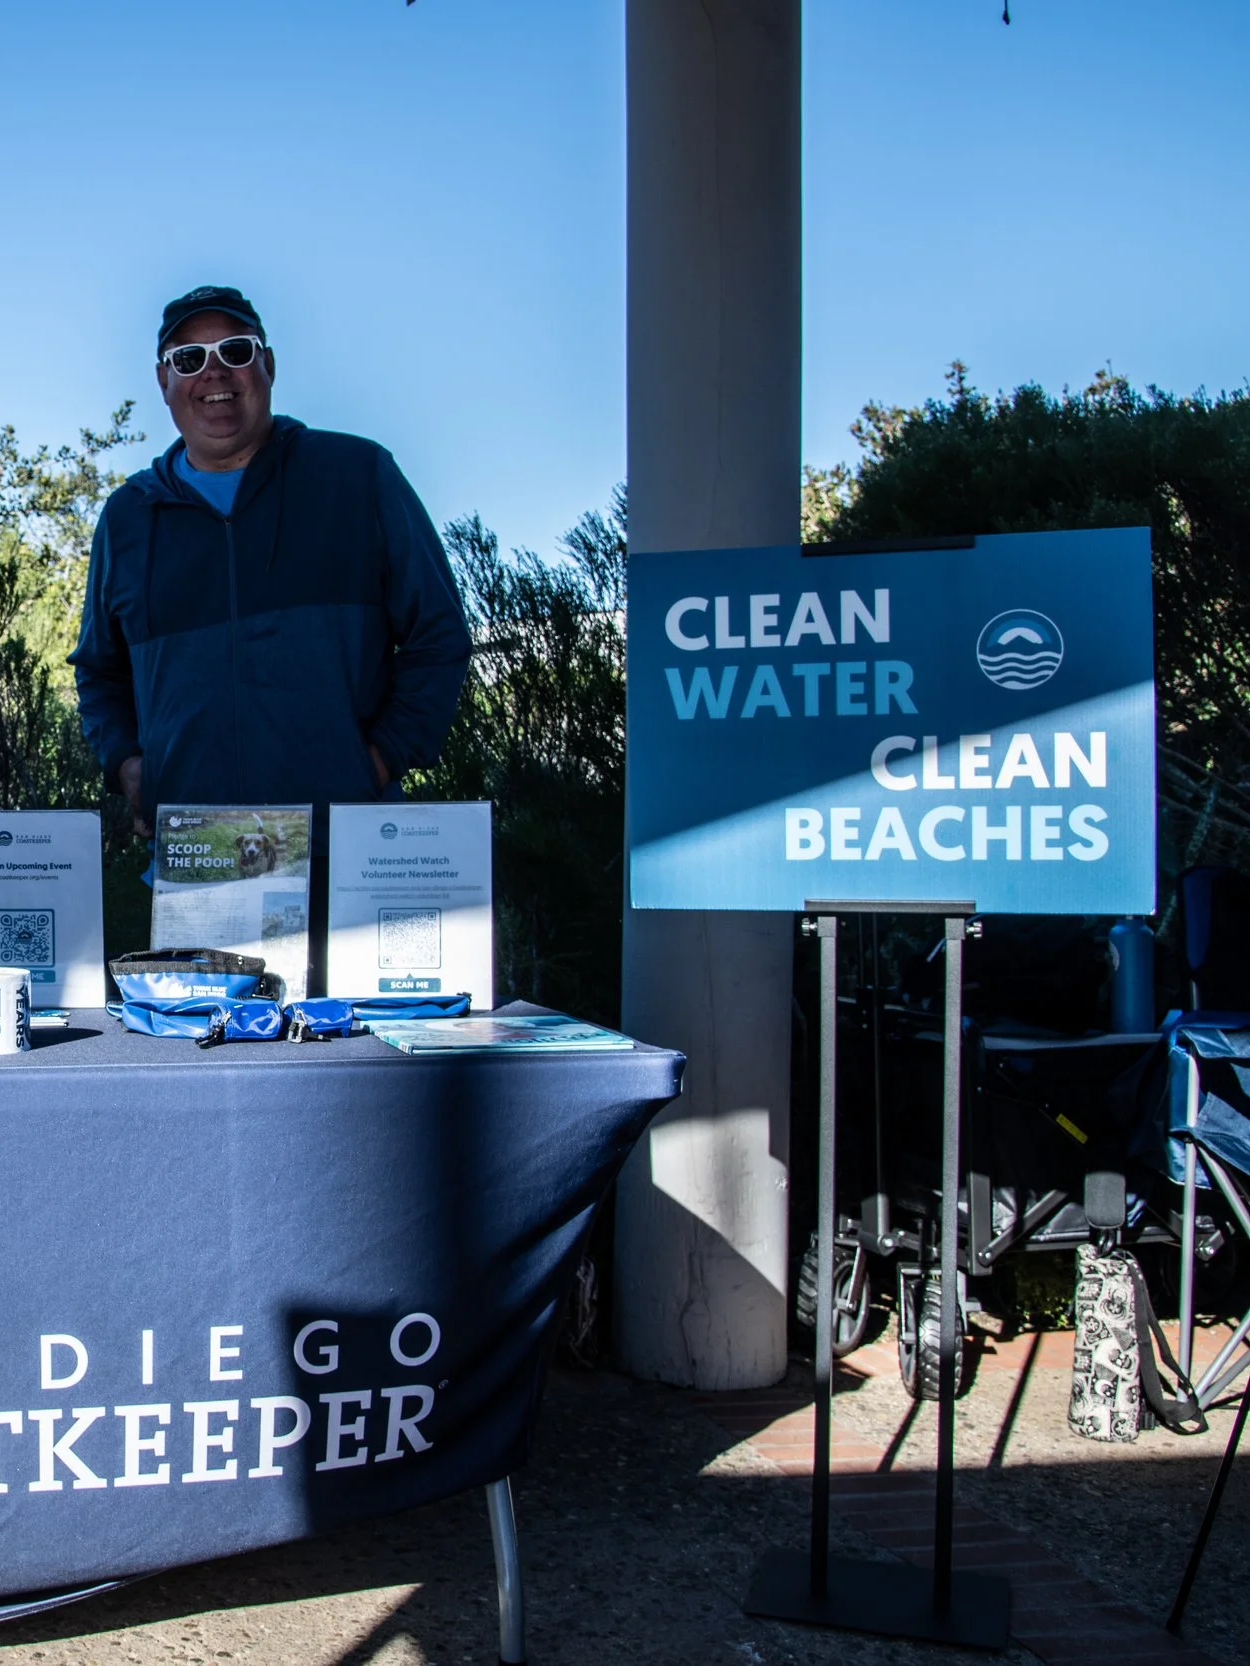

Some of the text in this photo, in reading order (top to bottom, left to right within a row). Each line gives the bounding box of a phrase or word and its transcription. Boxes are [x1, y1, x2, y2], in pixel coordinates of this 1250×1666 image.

[665, 589, 889, 651] CLEAN
[665, 660, 919, 720] WATER
[870, 731, 1107, 791] CLEAN
[167, 844, 211, 854] SCOOP
[785, 804, 1109, 862] BEACHES
[6, 862, 48, 871] Upcoming
[167, 857, 234, 867] THE POOP!
[361, 869, 459, 879] Volunteer Newsletter
[368, 856, 449, 865] Watershed Watch
[391, 981, 428, 989] SCAN ME
[16, 984, 26, 1048] YEARS
[41, 1313, 442, 1390] DIEGO
